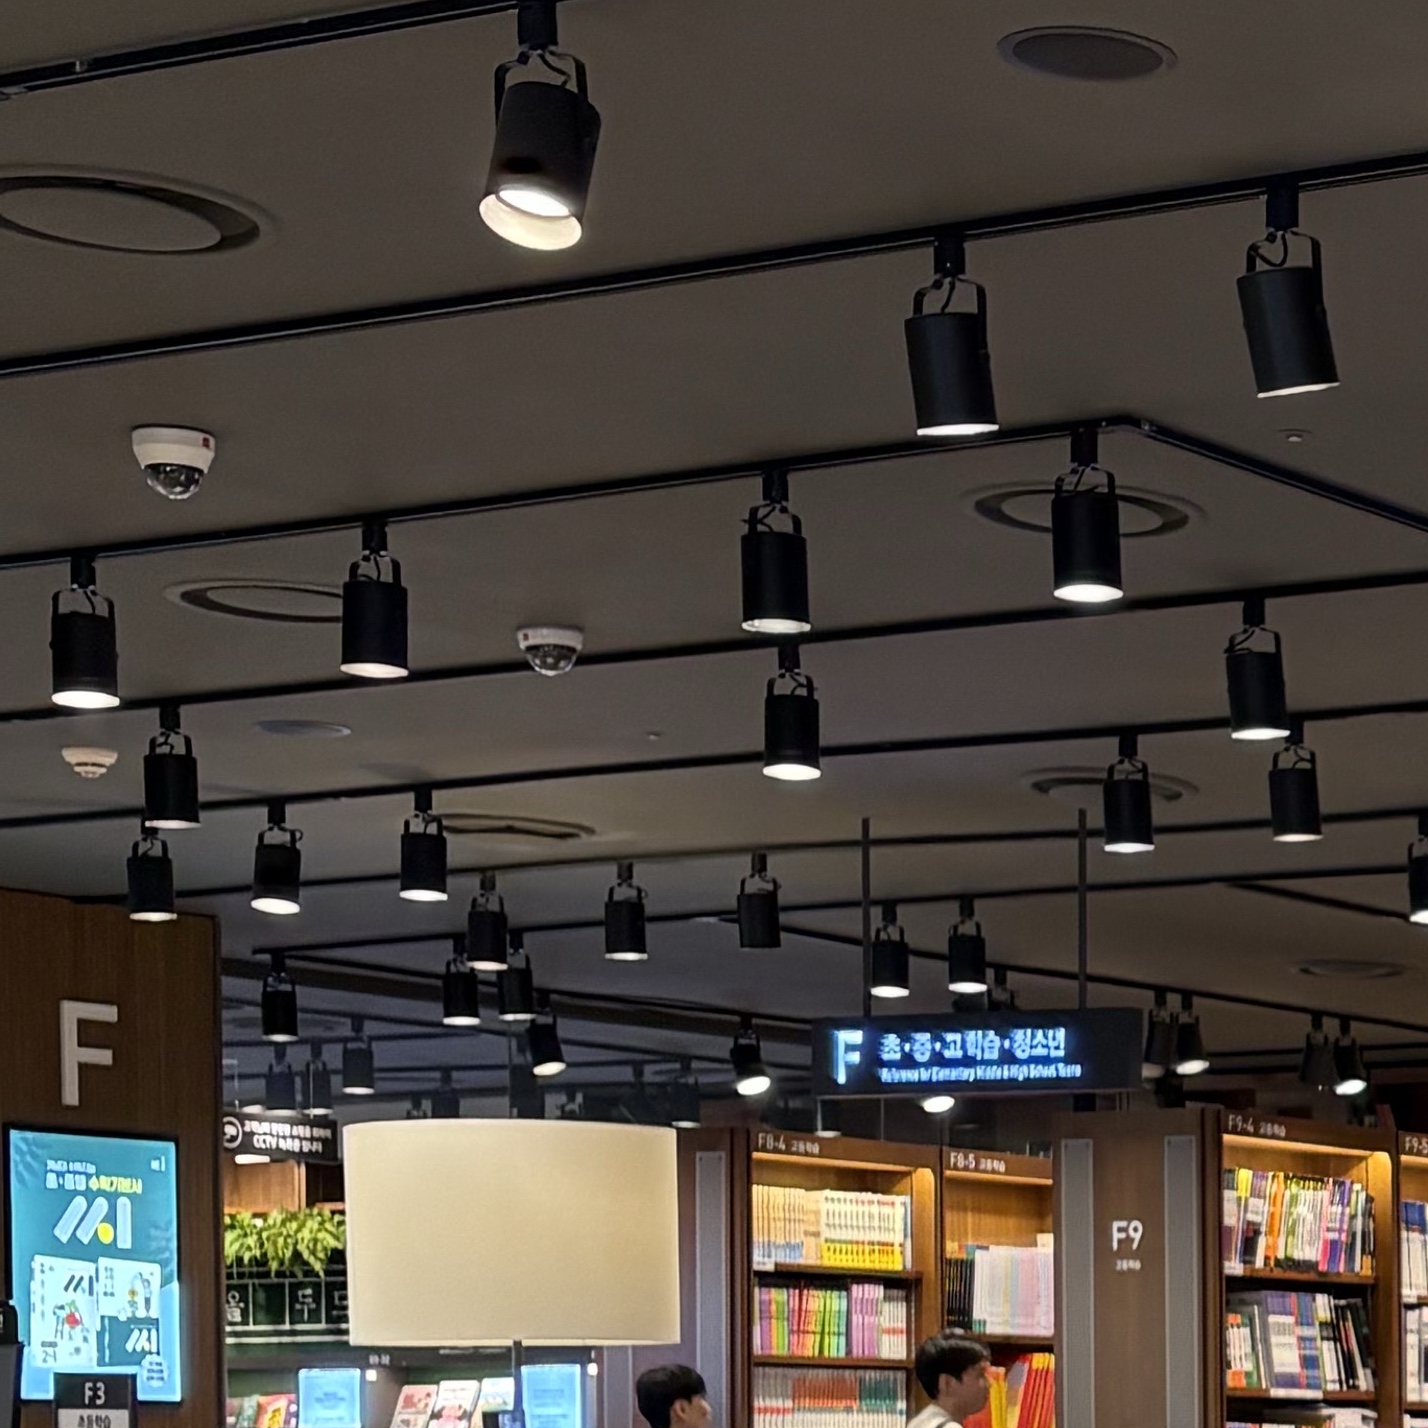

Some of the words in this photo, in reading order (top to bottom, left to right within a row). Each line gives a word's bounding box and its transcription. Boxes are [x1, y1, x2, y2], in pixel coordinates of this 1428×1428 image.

[60, 1000, 118, 1106] F
[833, 1029, 864, 1085] F
[1228, 1114, 1255, 1133] F9-4
[758, 1132, 786, 1152] F8-4
[1404, 1135, 1428, 1154] F9-5
[949, 1152, 976, 1170] F8-5
[1112, 1218, 1144, 1252] F9
